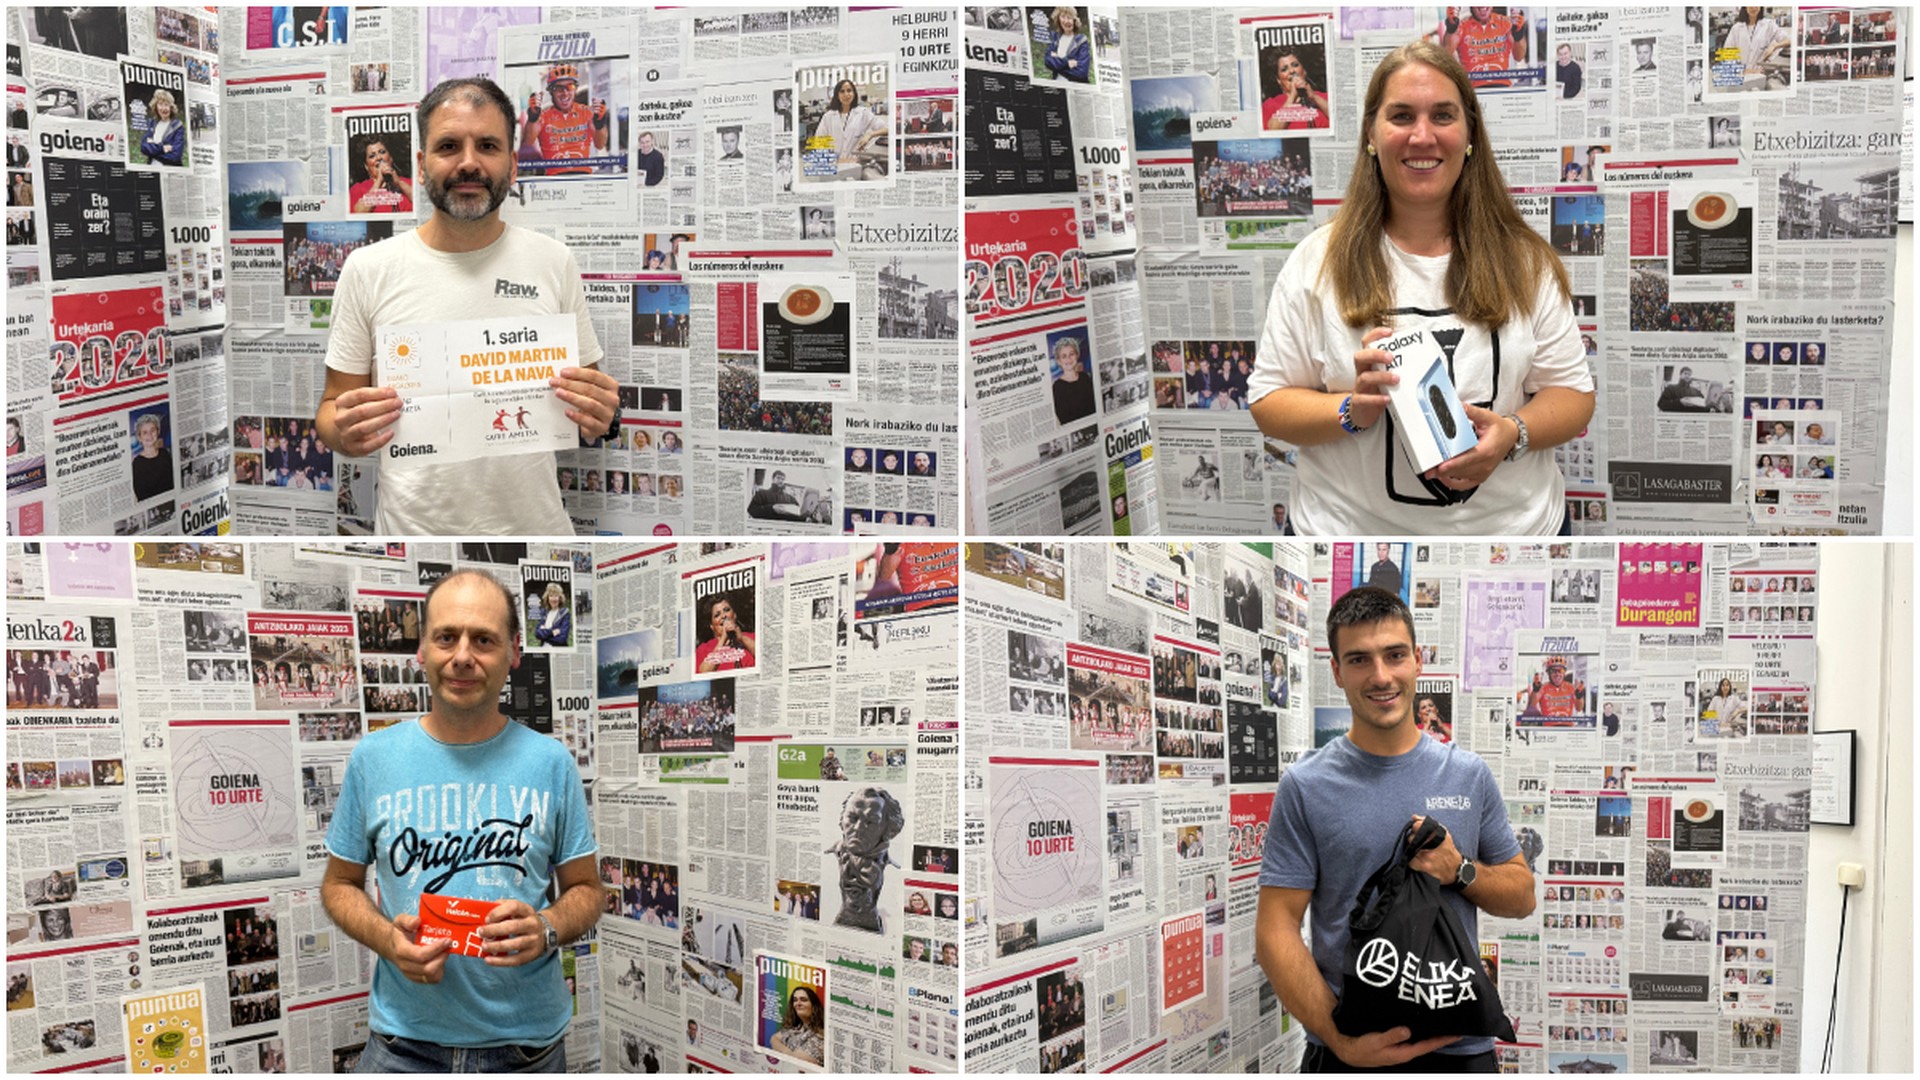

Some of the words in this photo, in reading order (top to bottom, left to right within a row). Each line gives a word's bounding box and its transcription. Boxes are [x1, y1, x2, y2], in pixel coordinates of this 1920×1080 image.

[892, 11, 947, 26] HELBURU
[277, 19, 343, 48] C.S.I.
[902, 30, 910, 41] 9
[913, 27, 948, 40] HERRI
[1259, 25, 1323, 50] puntua
[537, 38, 596, 60] ITZULIA
[901, 46, 915, 57] 10
[920, 43, 951, 56] URTE
[124, 63, 184, 91] puntua
[802, 63, 886, 92] puntua
[996, 107, 1015, 122] Eta
[349, 112, 411, 138] puntua
[989, 123, 1017, 135] orain
[1196, 117, 1233, 133] goiena
[40, 129, 105, 154] goiena
[993, 136, 1018, 152] zer?
[1753, 129, 1862, 152] Etxebizitza:
[1080, 146, 1121, 164] 1.000
[1604, 172, 1617, 181] Los
[91, 193, 109, 208] Eta
[288, 201, 321, 216] goiena
[83, 209, 110, 220] orain
[87, 220, 111, 236] zer?
[170, 227, 211, 244] 1.000
[850, 223, 958, 245] Etxebizitza
[970, 239, 1027, 257] Urtekaria
[689, 261, 701, 272] Los
[965, 248, 1091, 310] 2020
[59, 320, 114, 338] Urtekaria
[1746, 315, 1769, 325] Nork
[1771, 315, 1814, 325] irabaziko
[1816, 315, 1829, 325] du
[1831, 315, 1884, 326] lasterketa?
[483, 330, 496, 346] 1.
[499, 327, 538, 345] saria
[50, 325, 174, 389] 2020
[460, 351, 507, 369] DAVID
[509, 347, 568, 366] MARTIN
[472, 371, 491, 386] DE
[494, 368, 514, 384] LA
[516, 365, 556, 383] NAVA
[872, 418, 923, 431] irabaziko
[925, 420, 939, 432] du
[389, 443, 438, 459] Goiena.
[1643, 477, 1723, 492] LASAGABASTER
[523, 564, 571, 583] puntua
[697, 569, 755, 600] puntua
[1619, 606, 1697, 626] Durangon!
[641, 664, 672, 681] goiena
[557, 696, 590, 711] 1.000
[779, 748, 807, 762] G2a
[210, 774, 260, 790] GOIENA
[209, 791, 227, 806] 10
[229, 788, 263, 804] URTE
[376, 782, 550, 839] BROOKLYN
[1028, 819, 1073, 839] GOIENA
[390, 813, 534, 895] Original
[1027, 840, 1043, 857] 10
[1044, 836, 1075, 855] URTE
[423, 923, 453, 936] Tarjeta
[760, 956, 824, 988] puntua
[1401, 951, 1476, 984] ELIKA
[1397, 976, 1478, 1010] ENEA
[129, 990, 200, 1021] puntua
